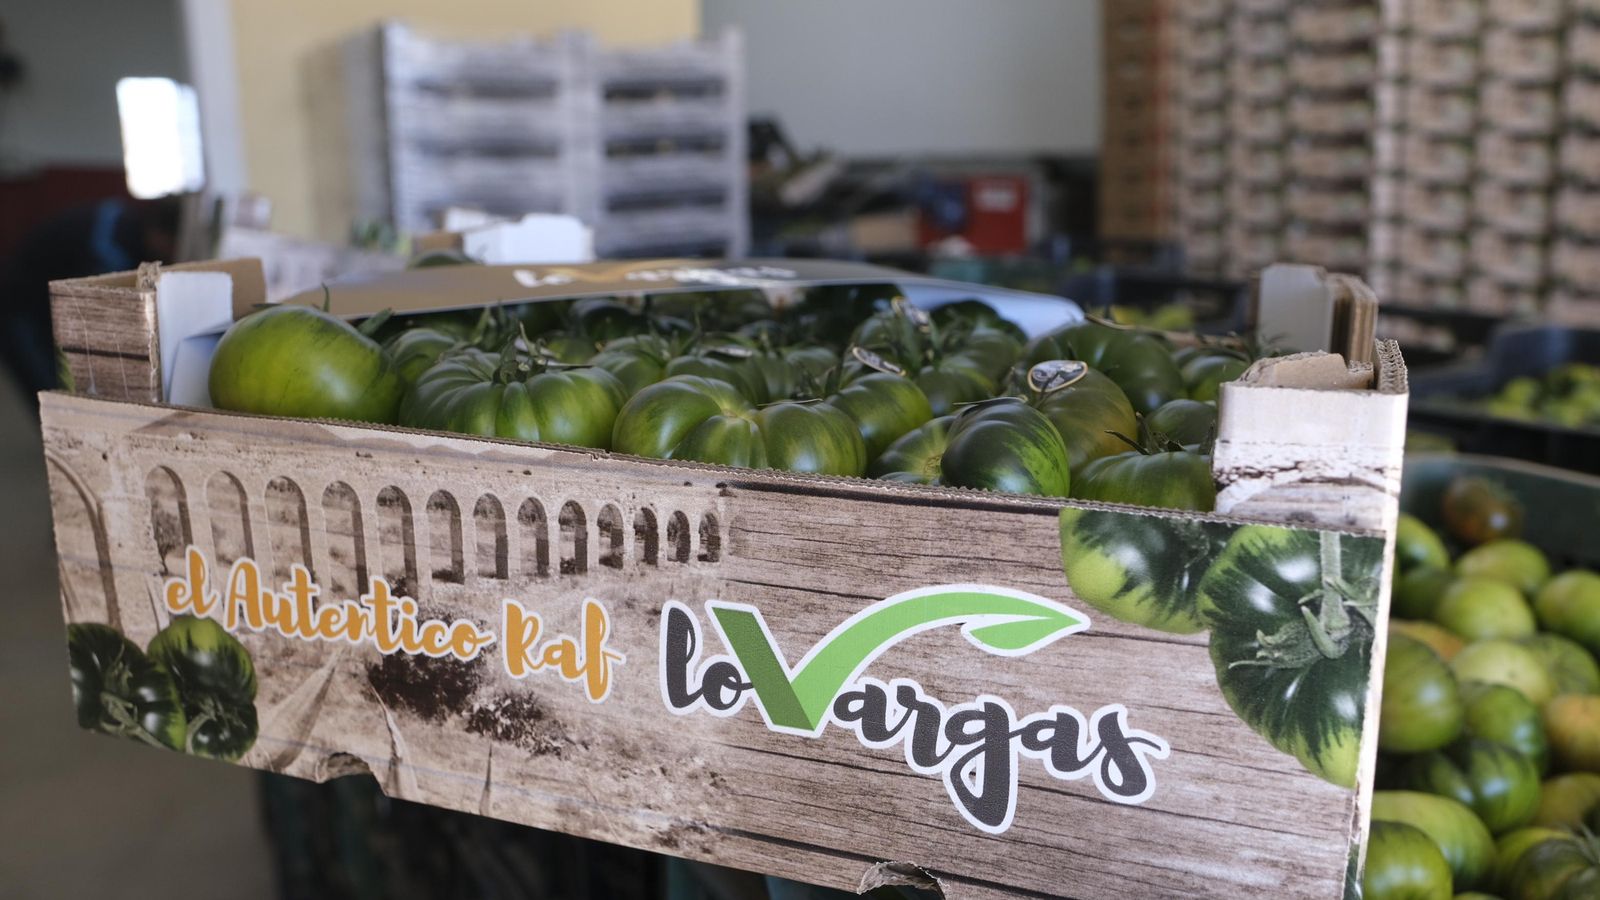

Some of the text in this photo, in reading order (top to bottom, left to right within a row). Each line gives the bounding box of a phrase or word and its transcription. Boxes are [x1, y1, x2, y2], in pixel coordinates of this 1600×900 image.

[165, 547, 624, 701] el Autentico Raf
